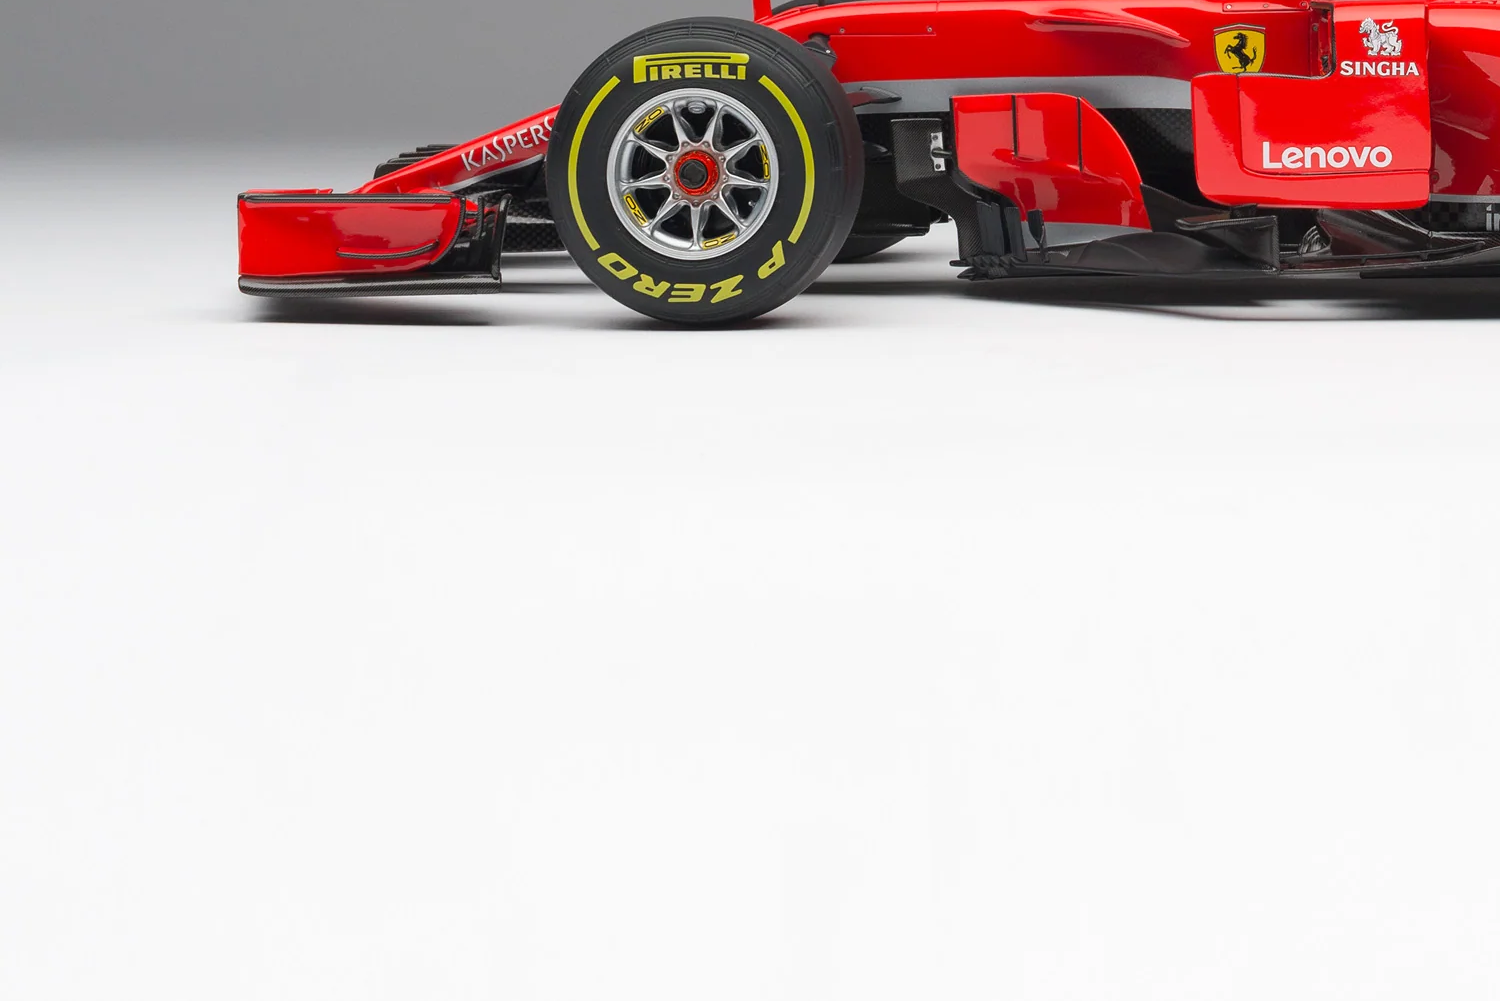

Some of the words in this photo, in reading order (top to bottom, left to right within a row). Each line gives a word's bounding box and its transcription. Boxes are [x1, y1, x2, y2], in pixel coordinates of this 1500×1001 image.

[633, 52, 750, 84] PIRELLI
[1340, 60, 1419, 76] SINGHA
[461, 115, 556, 171] KASPERS
[1262, 141, 1393, 169] Lenovo
[597, 252, 744, 303] ZERO
[757, 240, 786, 280] P
